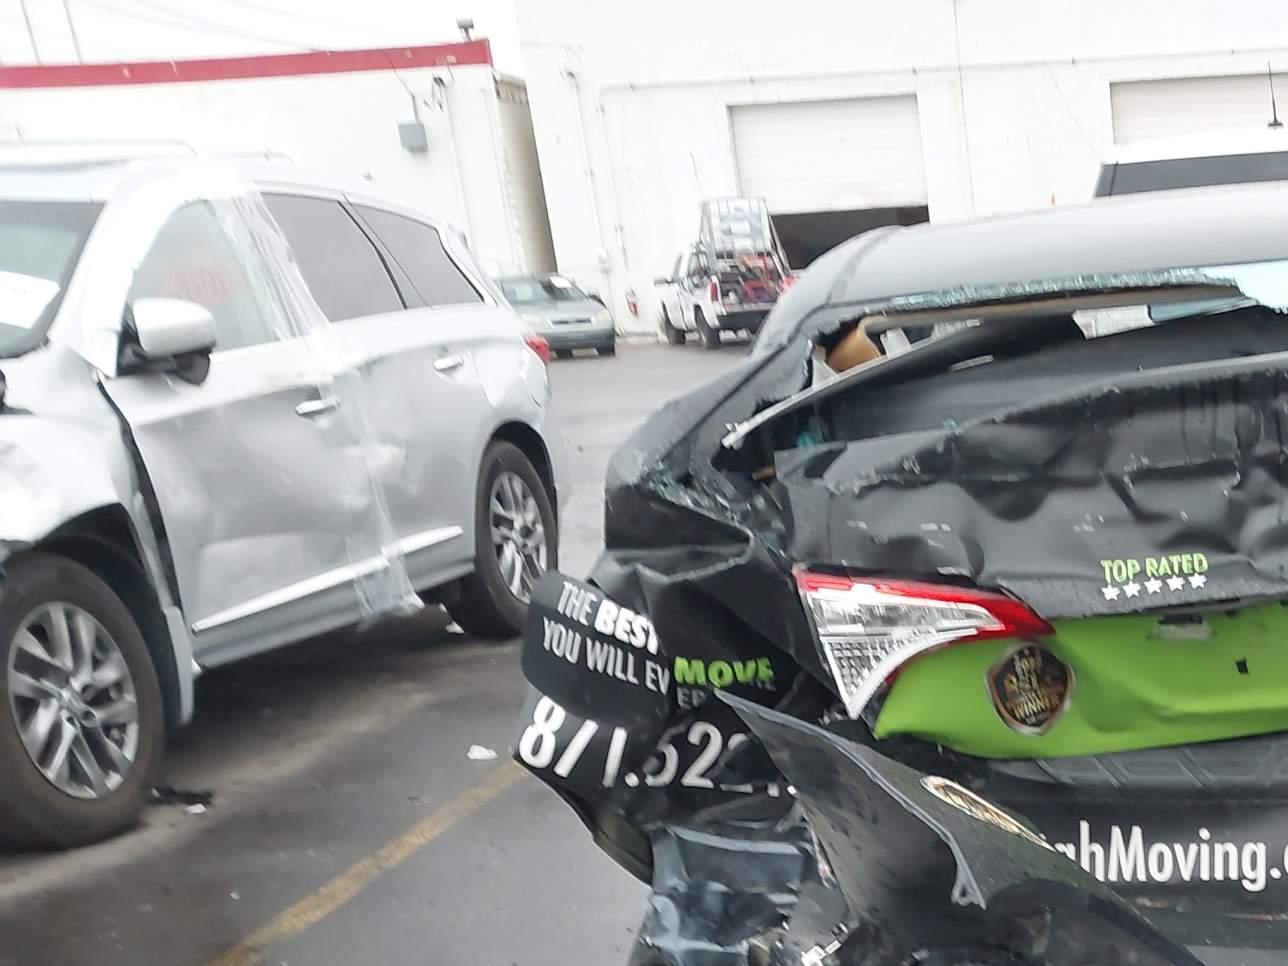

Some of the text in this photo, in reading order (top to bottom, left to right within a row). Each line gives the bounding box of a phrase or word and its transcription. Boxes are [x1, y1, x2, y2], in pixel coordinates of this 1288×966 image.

[1100, 552, 1208, 584] TOP RATED
[543, 615, 582, 664] YOU
[586, 636, 639, 685] WILL
[557, 580, 774, 688] THE BEST MOVE
